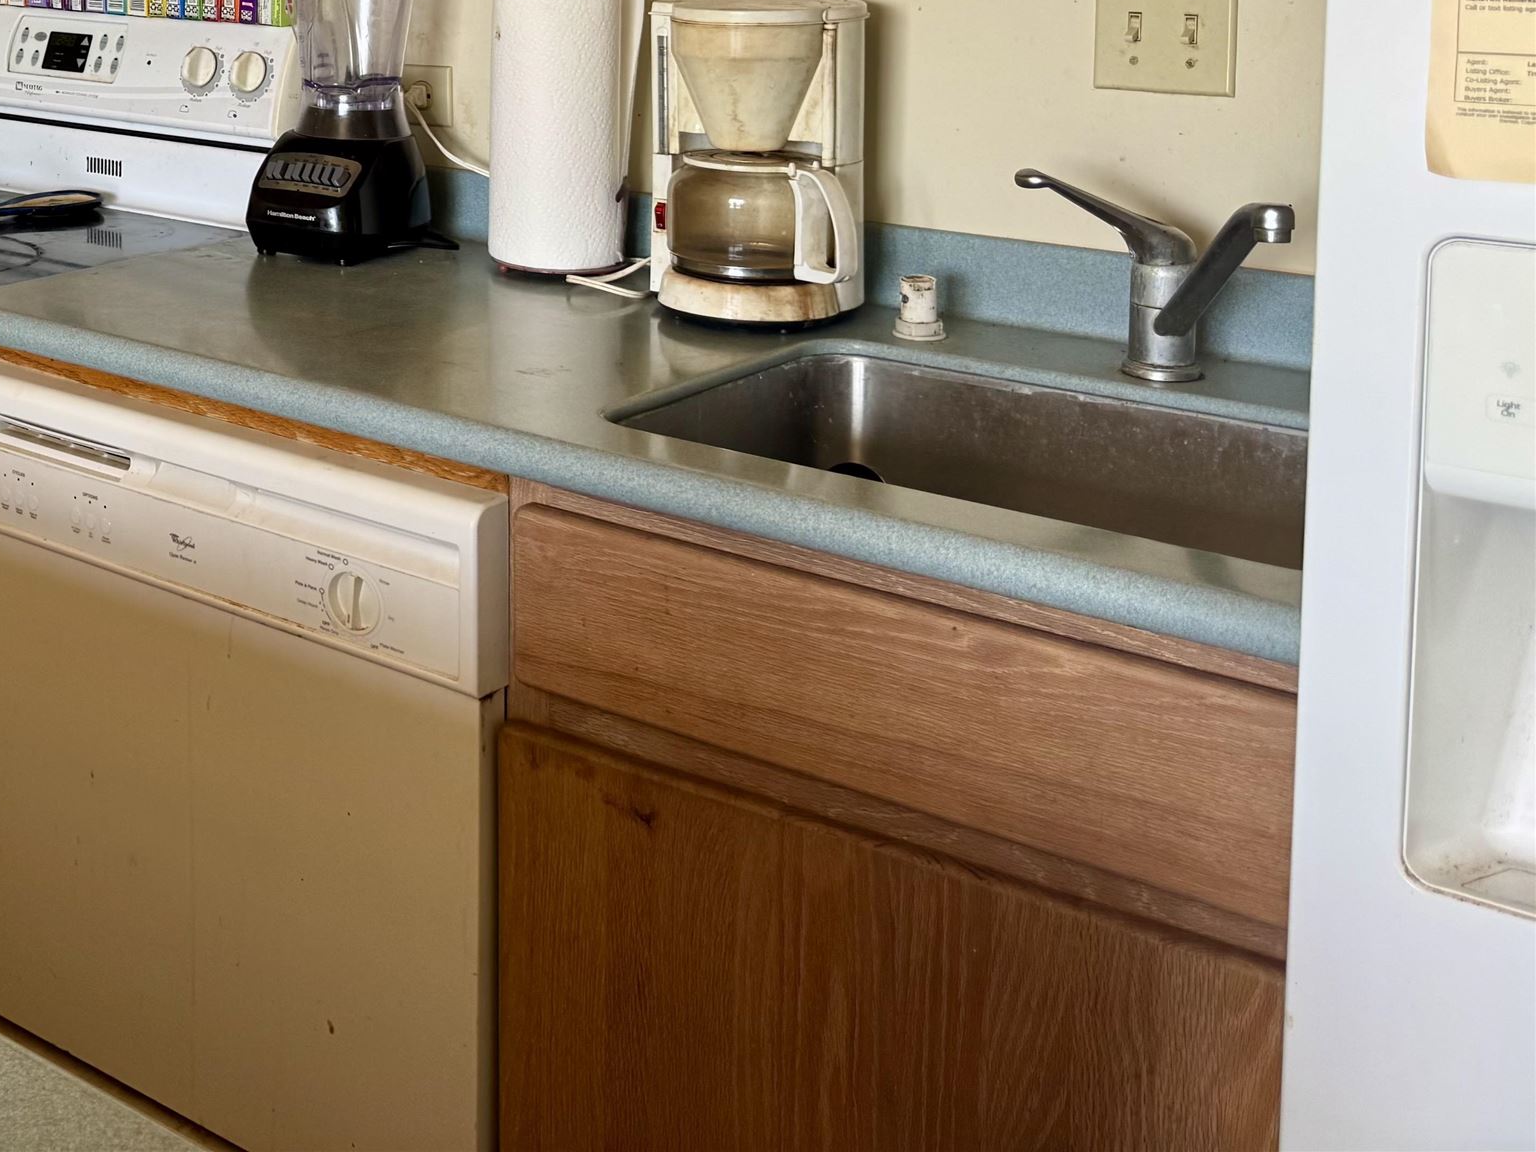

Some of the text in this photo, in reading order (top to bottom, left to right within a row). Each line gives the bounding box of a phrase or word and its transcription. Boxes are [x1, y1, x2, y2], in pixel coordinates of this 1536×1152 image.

[267, 209, 316, 222] Hamilton Beach
[1496, 400, 1521, 412] Light
[1500, 409, 1516, 418] On
